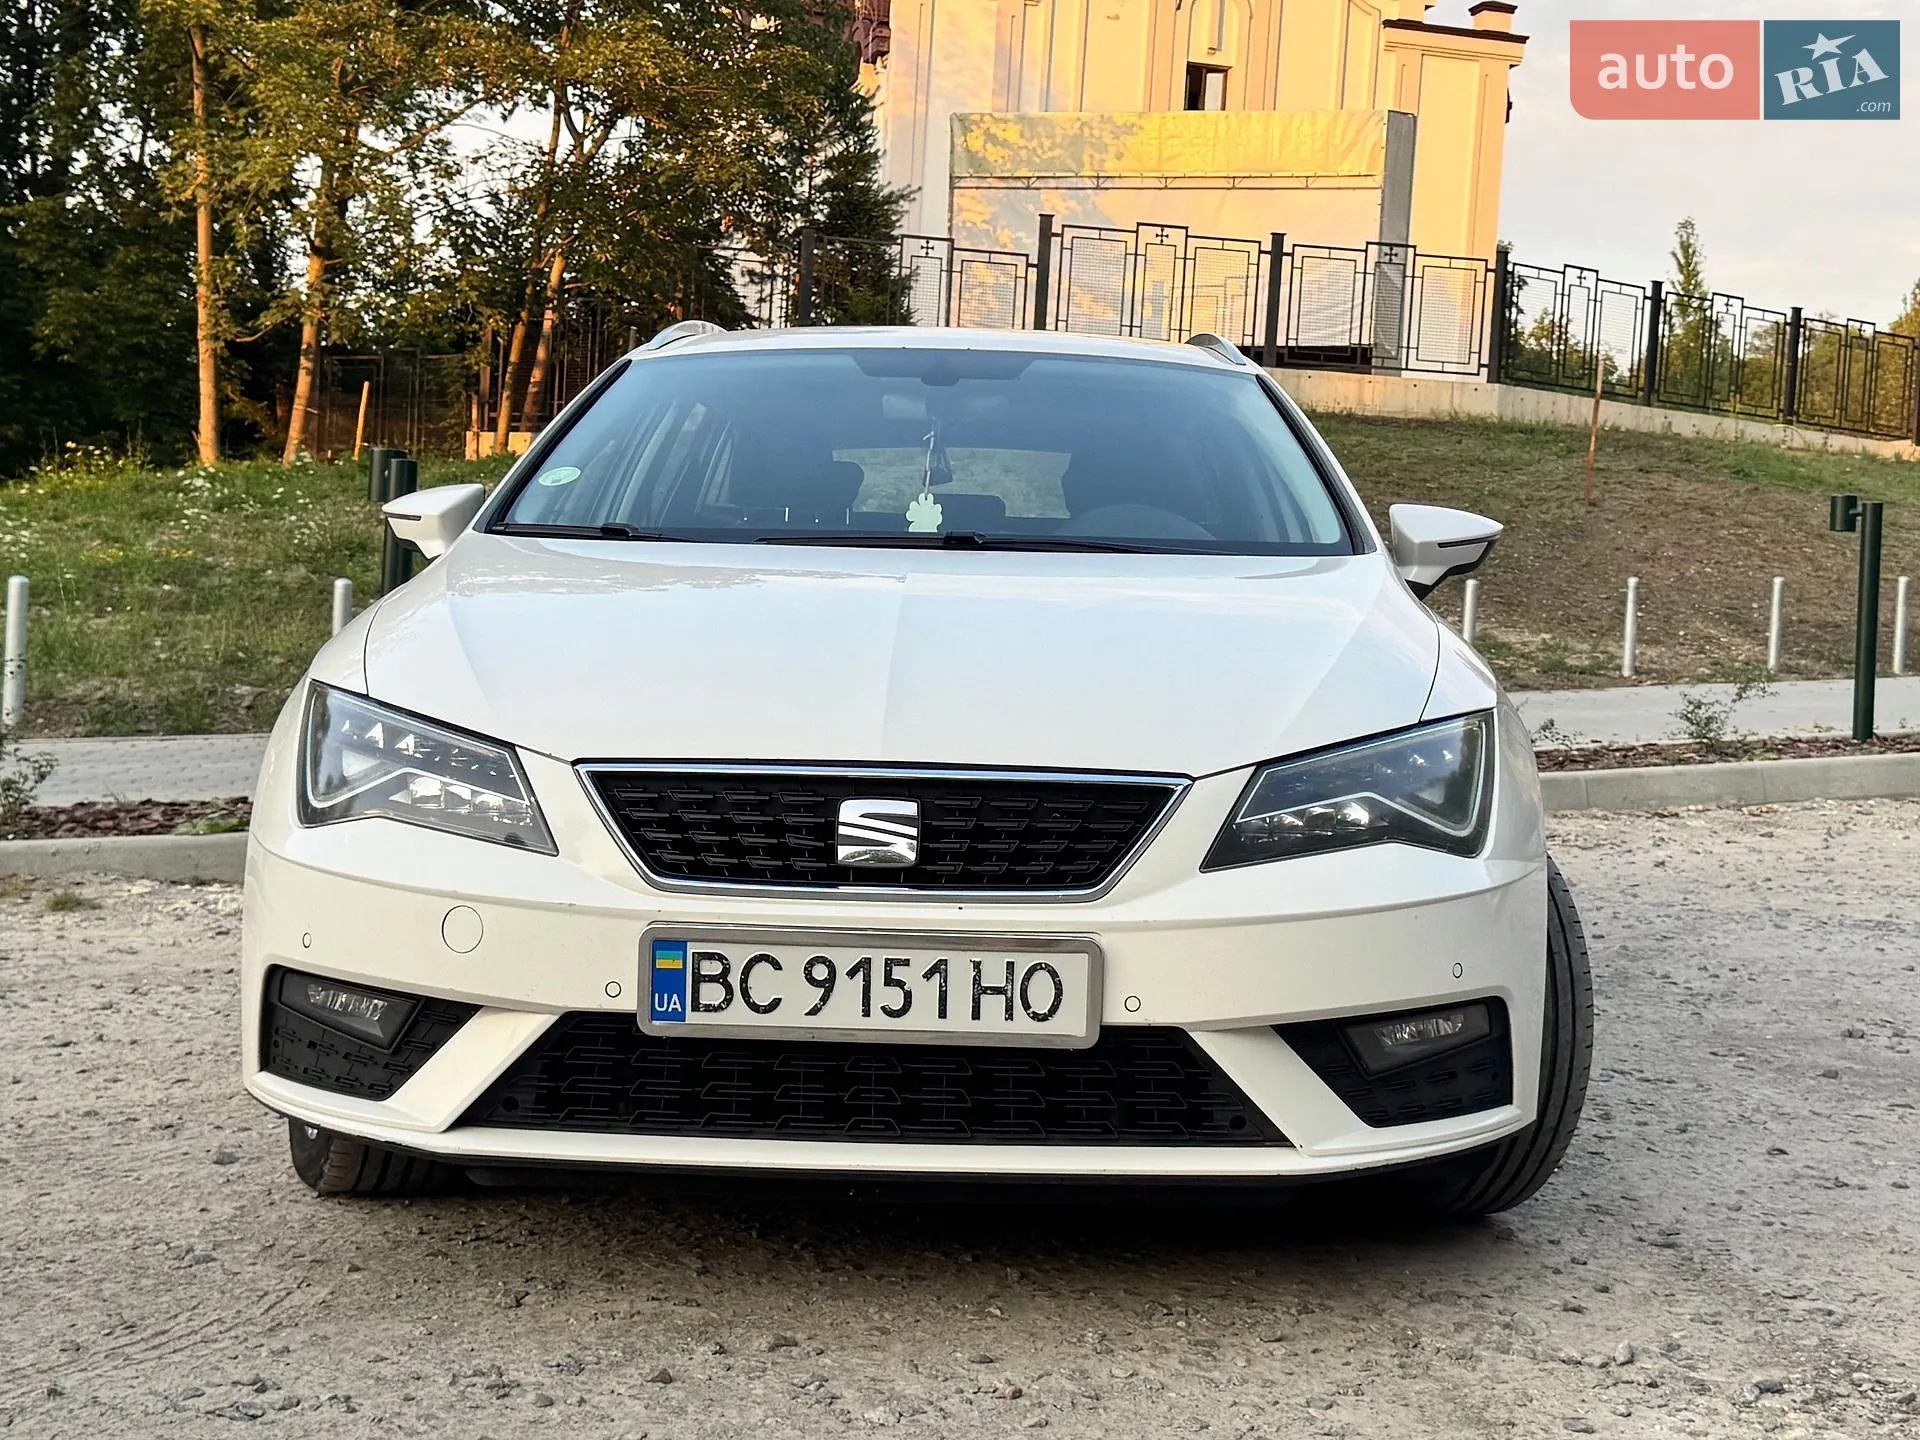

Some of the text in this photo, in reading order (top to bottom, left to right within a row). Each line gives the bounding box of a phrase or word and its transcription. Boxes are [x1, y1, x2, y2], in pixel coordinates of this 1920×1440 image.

[654, 992, 682, 1012] UA
[690, 951, 1064, 1023] BC 9151 HO
